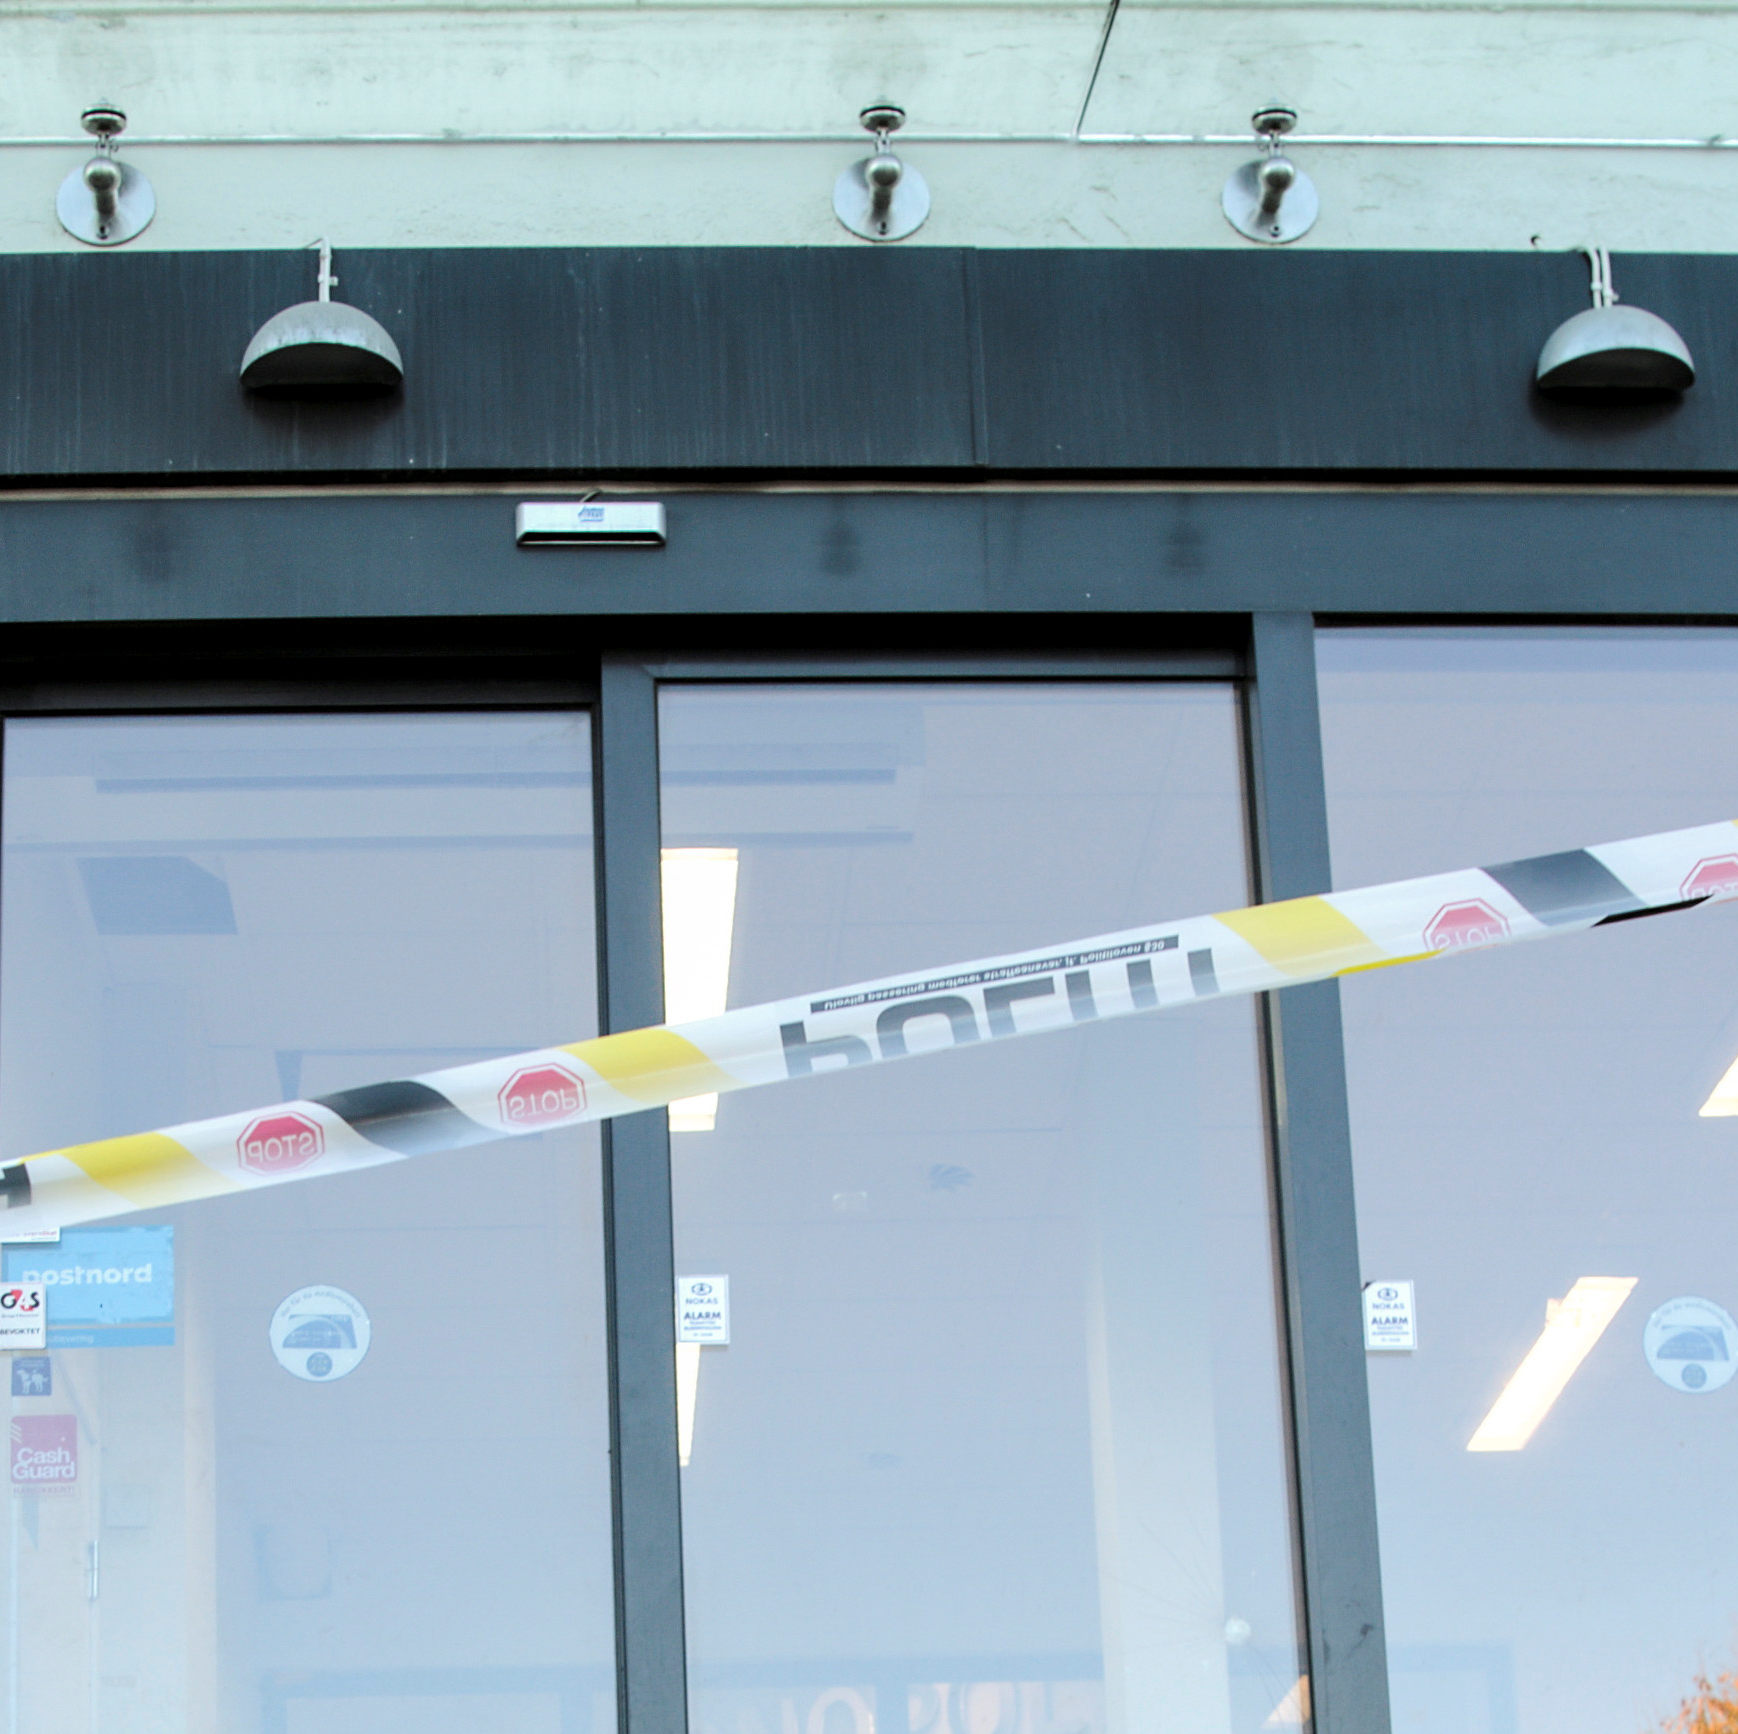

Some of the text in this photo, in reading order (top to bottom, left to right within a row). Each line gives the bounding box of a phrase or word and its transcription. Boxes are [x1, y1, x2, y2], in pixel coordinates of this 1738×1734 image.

[22, 1263, 153, 1286] postnord
[0, 1289, 40, 1312] G4S
[684, 1311, 722, 1320] ALARM
[1371, 1316, 1409, 1325] ALARM
[0, 1327, 41, 1336] BEVOKTET
[16, 1447, 70, 1465] Cash
[12, 1461, 76, 1480] Guard
